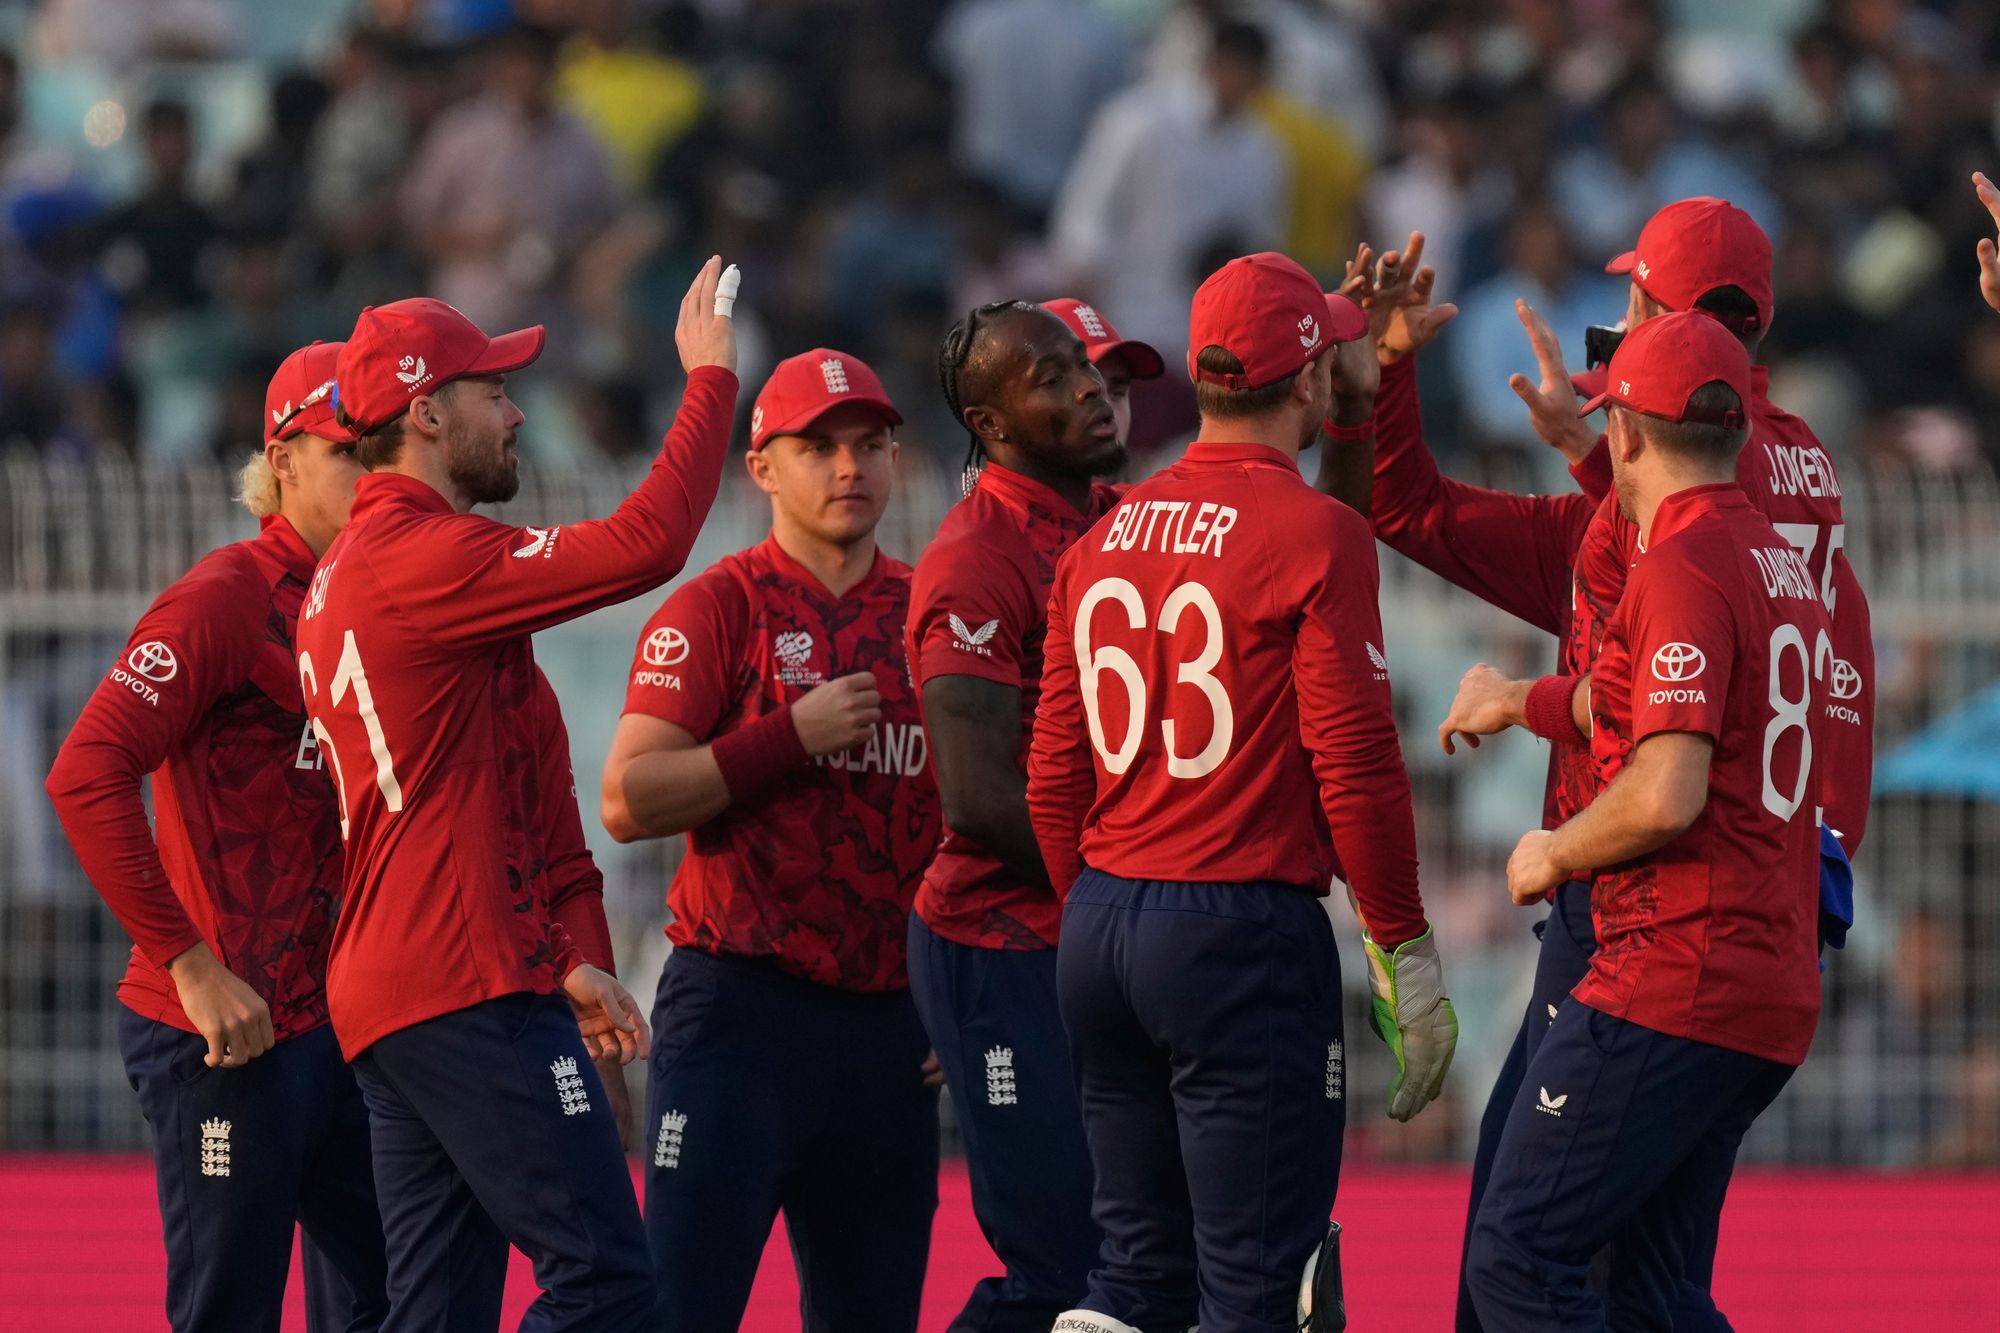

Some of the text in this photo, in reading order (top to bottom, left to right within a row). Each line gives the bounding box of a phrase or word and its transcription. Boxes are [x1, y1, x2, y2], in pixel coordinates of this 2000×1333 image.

[1298, 314, 1313, 332] 150
[399, 355, 415, 371] 50
[1619, 380, 1631, 396] 76
[1101, 501, 1238, 558] BUTTLER
[109, 668, 160, 707] TOYOTA
[634, 671, 681, 691] TOYOTA
[1074, 577, 1234, 779] 63
[1648, 689, 1707, 706] TOYOTA
